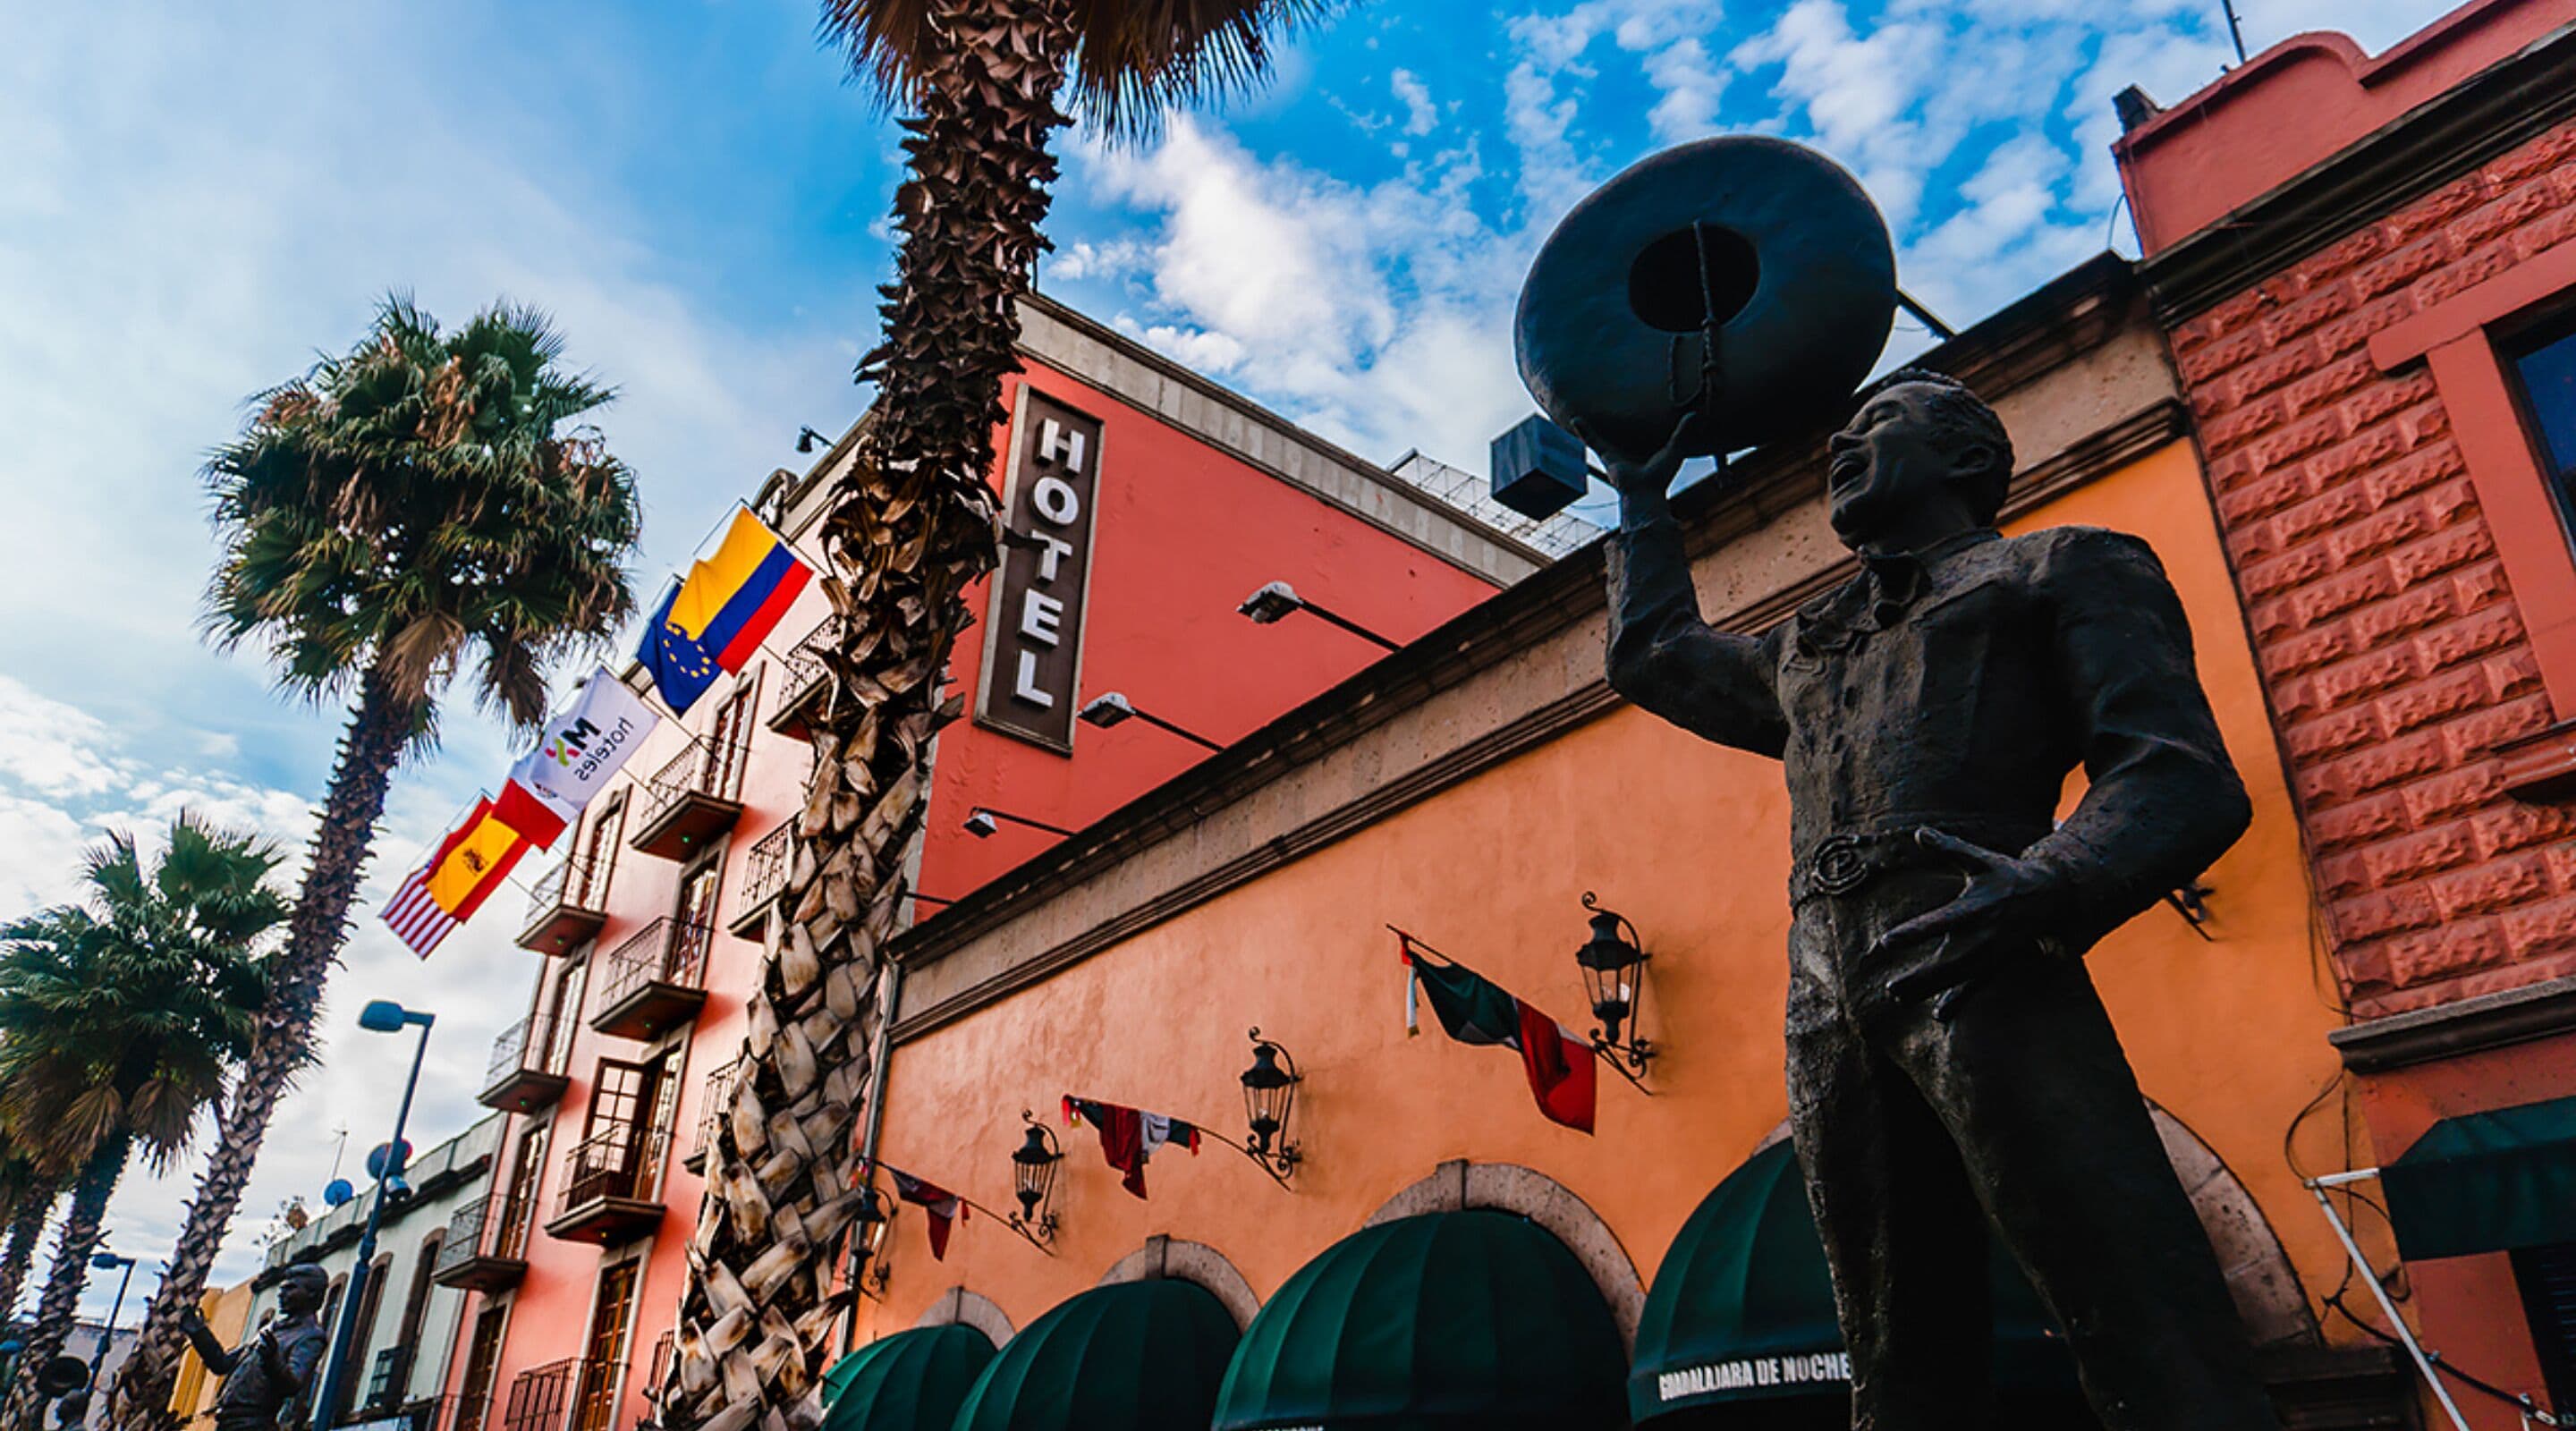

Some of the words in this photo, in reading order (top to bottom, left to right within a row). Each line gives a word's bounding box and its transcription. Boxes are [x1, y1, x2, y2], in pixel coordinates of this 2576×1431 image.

[1013, 417, 1085, 709] HOTEL
[1658, 1359, 1754, 1401] GUADALAJARA
[1755, 1357, 1781, 1385] DE
[1782, 1352, 1852, 1382] NOCHE
